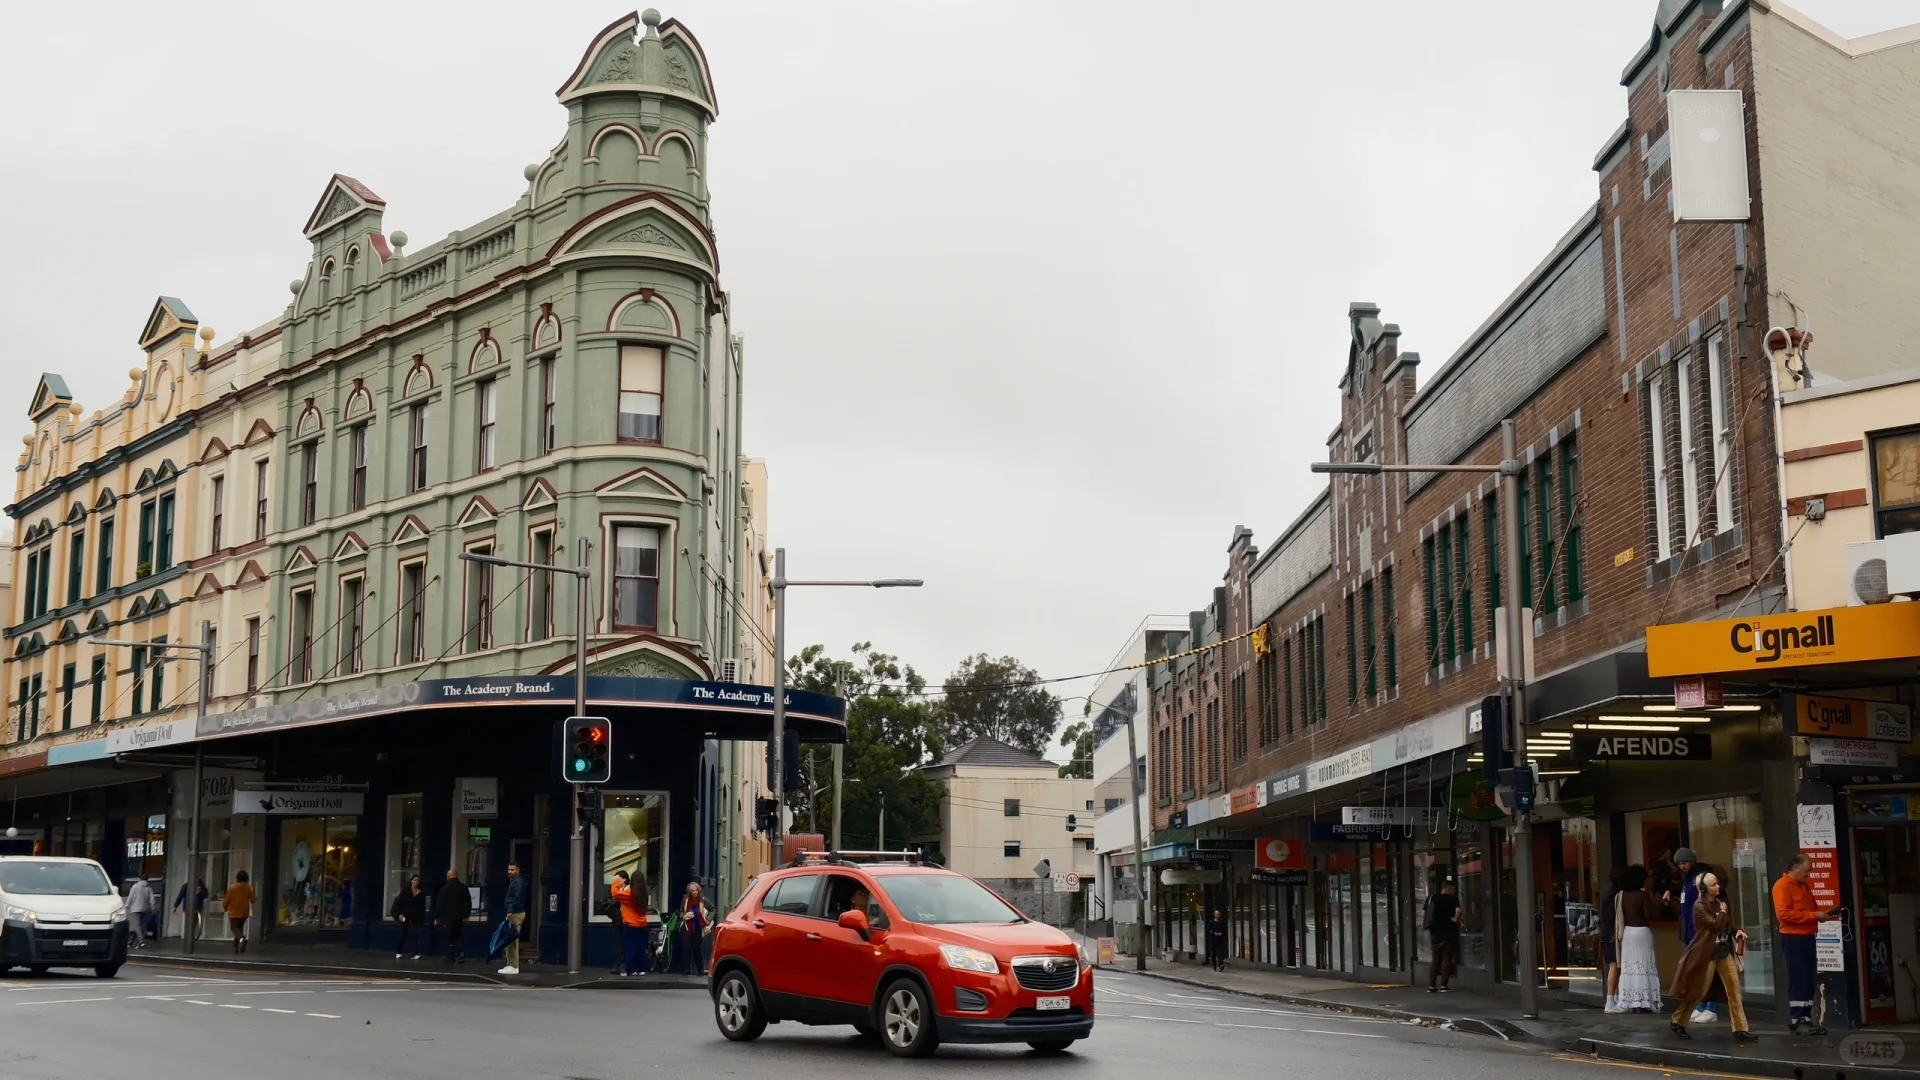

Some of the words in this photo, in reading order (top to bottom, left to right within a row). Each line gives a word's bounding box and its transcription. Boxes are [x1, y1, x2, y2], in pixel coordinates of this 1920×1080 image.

[1694, 189, 1733, 208] blue
[1730, 615, 1835, 663] Cignall
[443, 685, 461, 696] The
[464, 684, 512, 697] Academy
[515, 682, 551, 693] Brand
[693, 686, 714, 699] The
[717, 688, 761, 706] Academy
[763, 692, 790, 705] Brd
[1680, 691, 1699, 703] HERE
[1808, 699, 1852, 731] Cignall
[1875, 713, 1889, 722] NSW
[130, 727, 158, 747] Origami
[158, 724, 173, 742] Doll
[1875, 722, 1908, 738] Lotteries
[1596, 737, 1689, 756] AFENDS
[1833, 740, 1852, 749] SHOE
[201, 776, 235, 798] FORA
[275, 796, 319, 810] Origami
[321, 797, 342, 809] Doll
[463, 797, 495, 806] Academy
[1332, 824, 1381, 833] FABRIQUE
[137, 841, 150, 857] REL
[1251, 873, 1262, 881] WE
